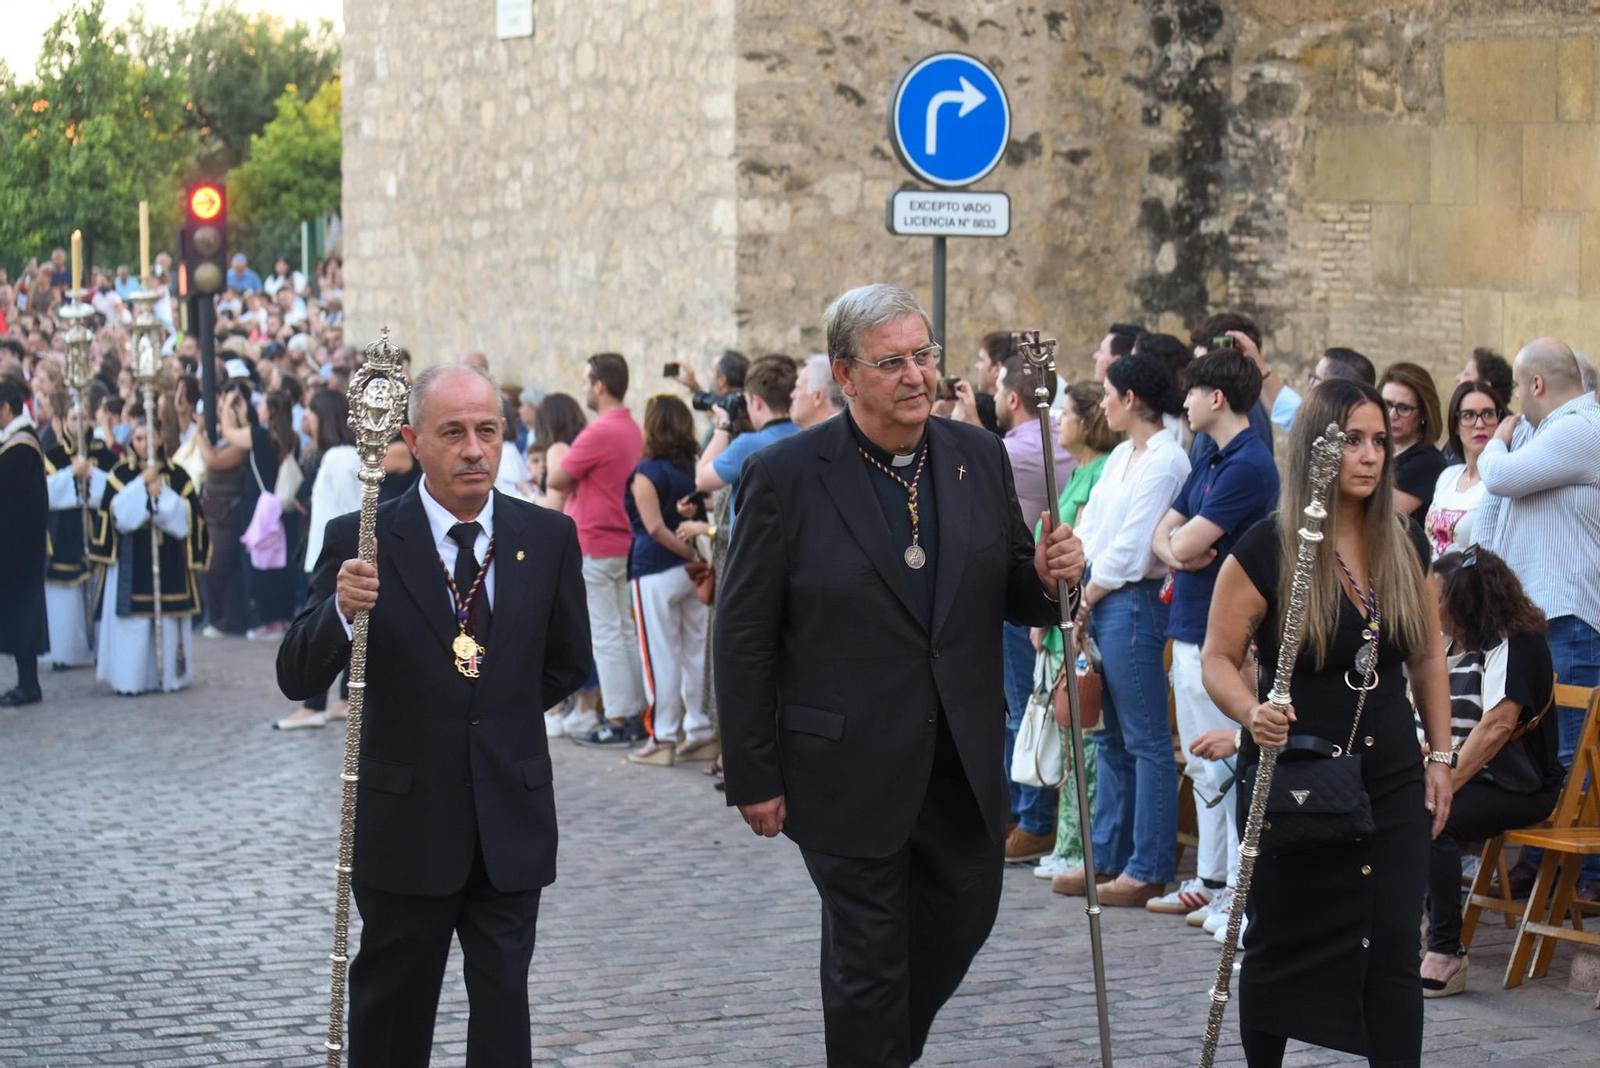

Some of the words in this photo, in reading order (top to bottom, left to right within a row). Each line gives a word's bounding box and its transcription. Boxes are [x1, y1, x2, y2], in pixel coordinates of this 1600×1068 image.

[909, 200, 960, 212] EXCEPTO
[962, 202, 992, 214] VADO
[904, 216, 955, 227] LICENCIA
